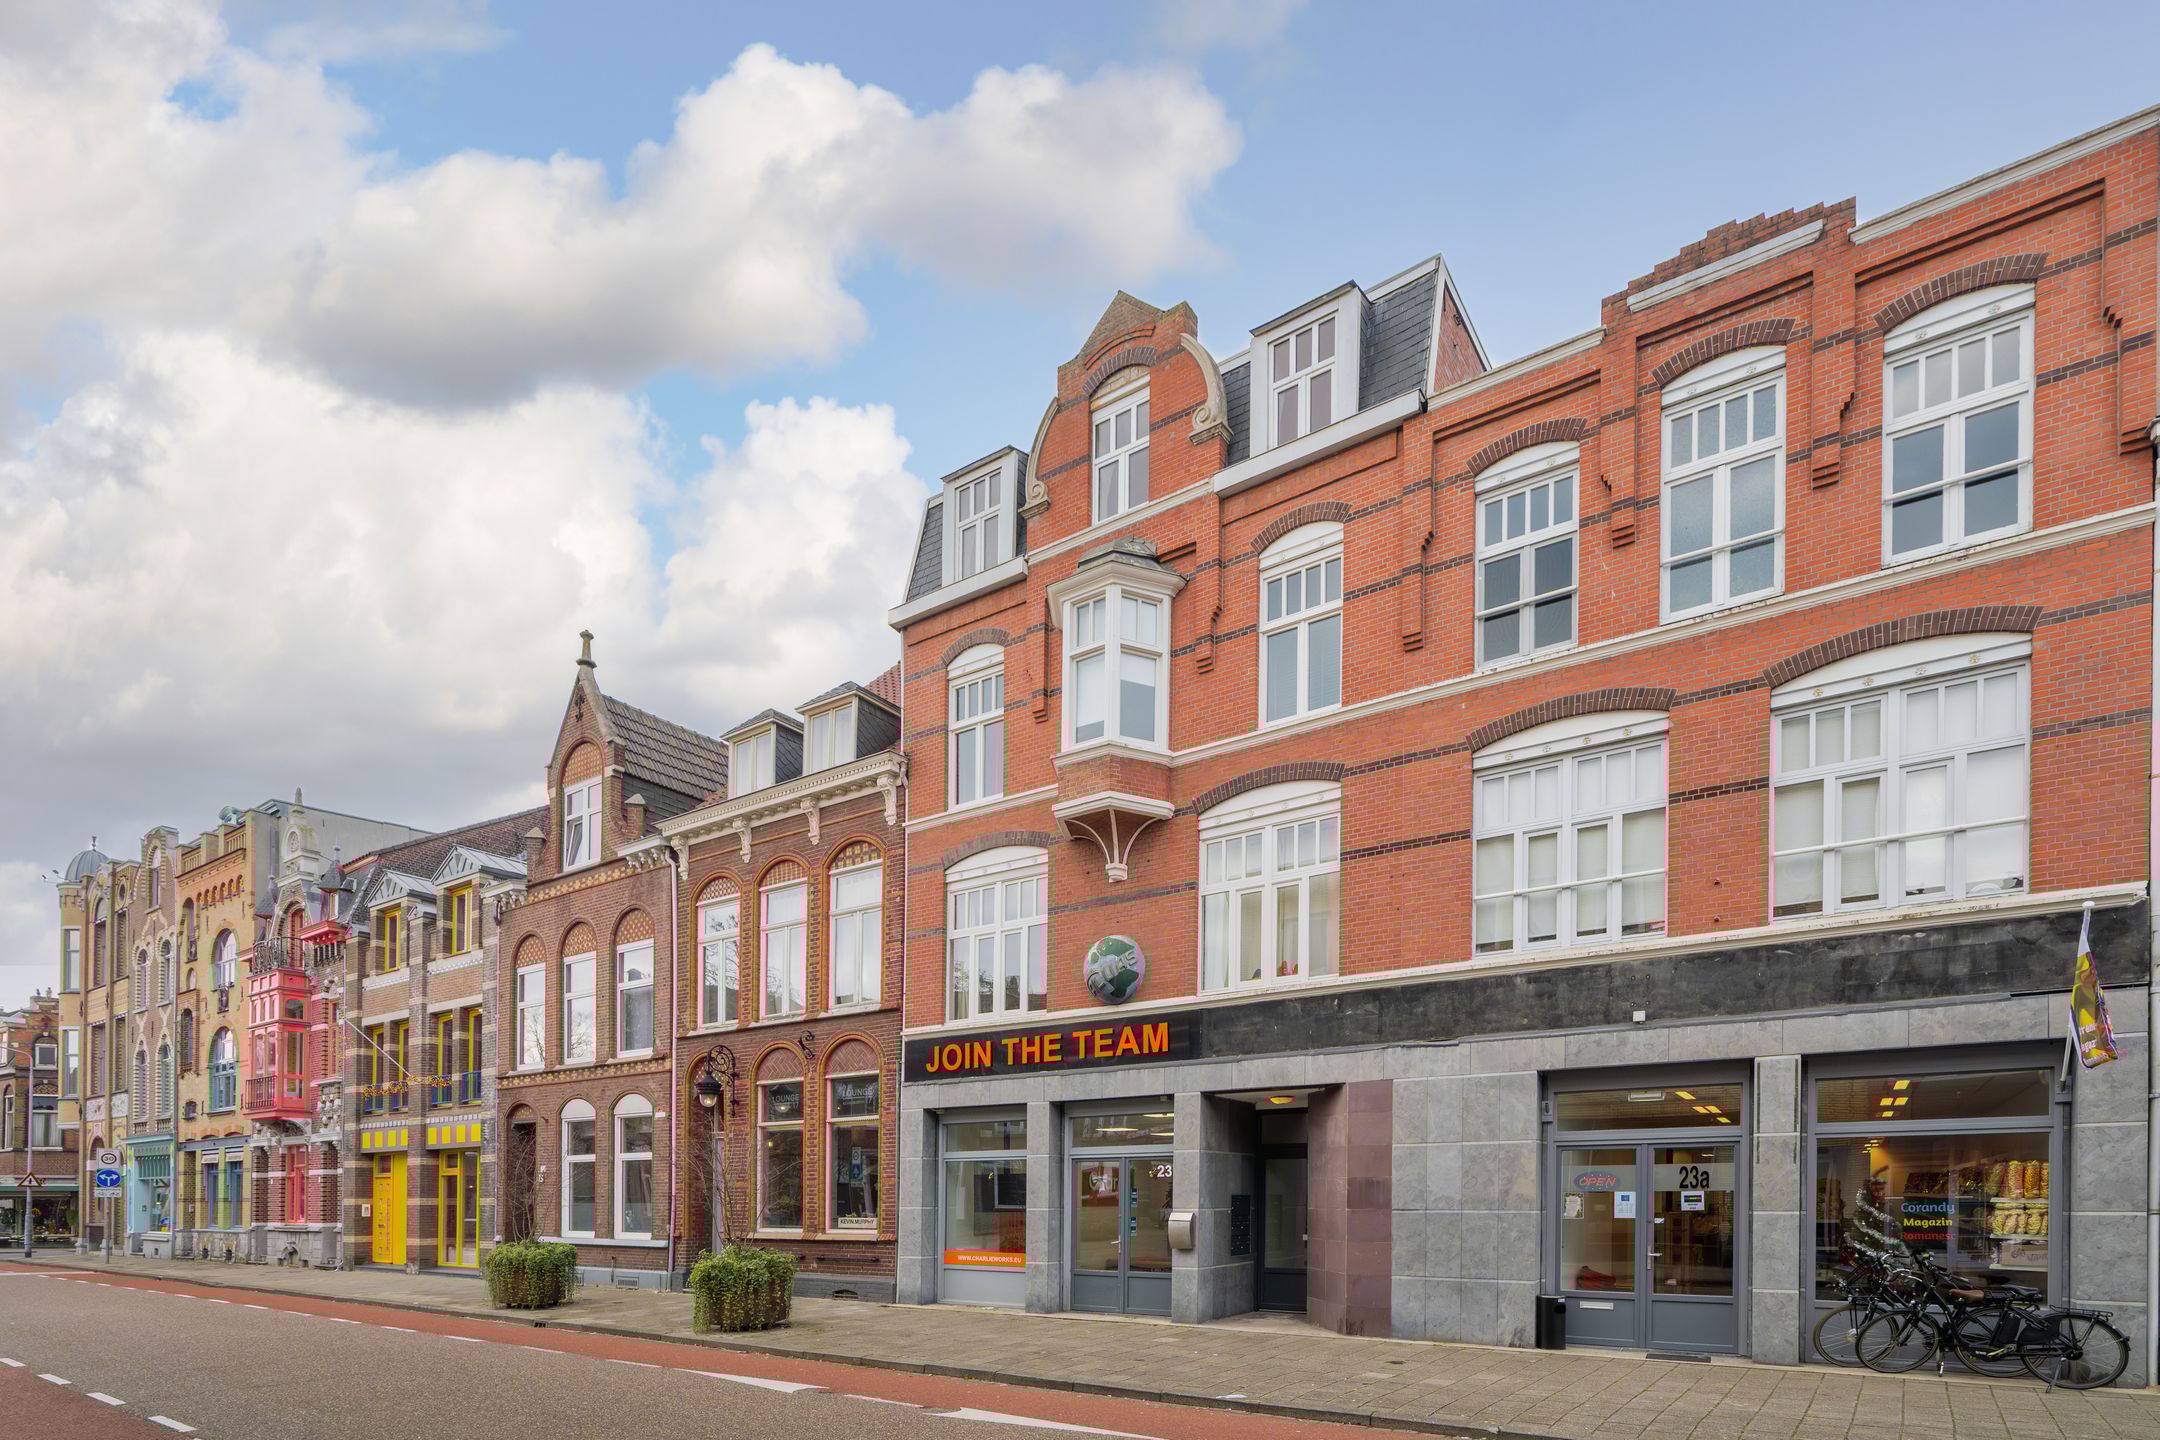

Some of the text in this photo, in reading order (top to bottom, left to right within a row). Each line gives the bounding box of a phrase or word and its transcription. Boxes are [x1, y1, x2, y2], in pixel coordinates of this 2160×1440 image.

[925, 1022, 1169, 1073] JOIN THE TEAM
[842, 1087, 874, 1097] LOUNGE
[772, 1093, 800, 1103] LOUNGE
[1156, 1164, 1173, 1178] 23
[1579, 1176, 1617, 1187] OPEN
[1679, 1165, 1710, 1189] 23a
[1900, 1202, 1955, 1214] Corandy
[1903, 1217, 1953, 1229] Magazin
[1900, 1231, 1955, 1240] Romanesc
[957, 1255, 1022, 1264] WWW.CHARLIEWORKS.EU
